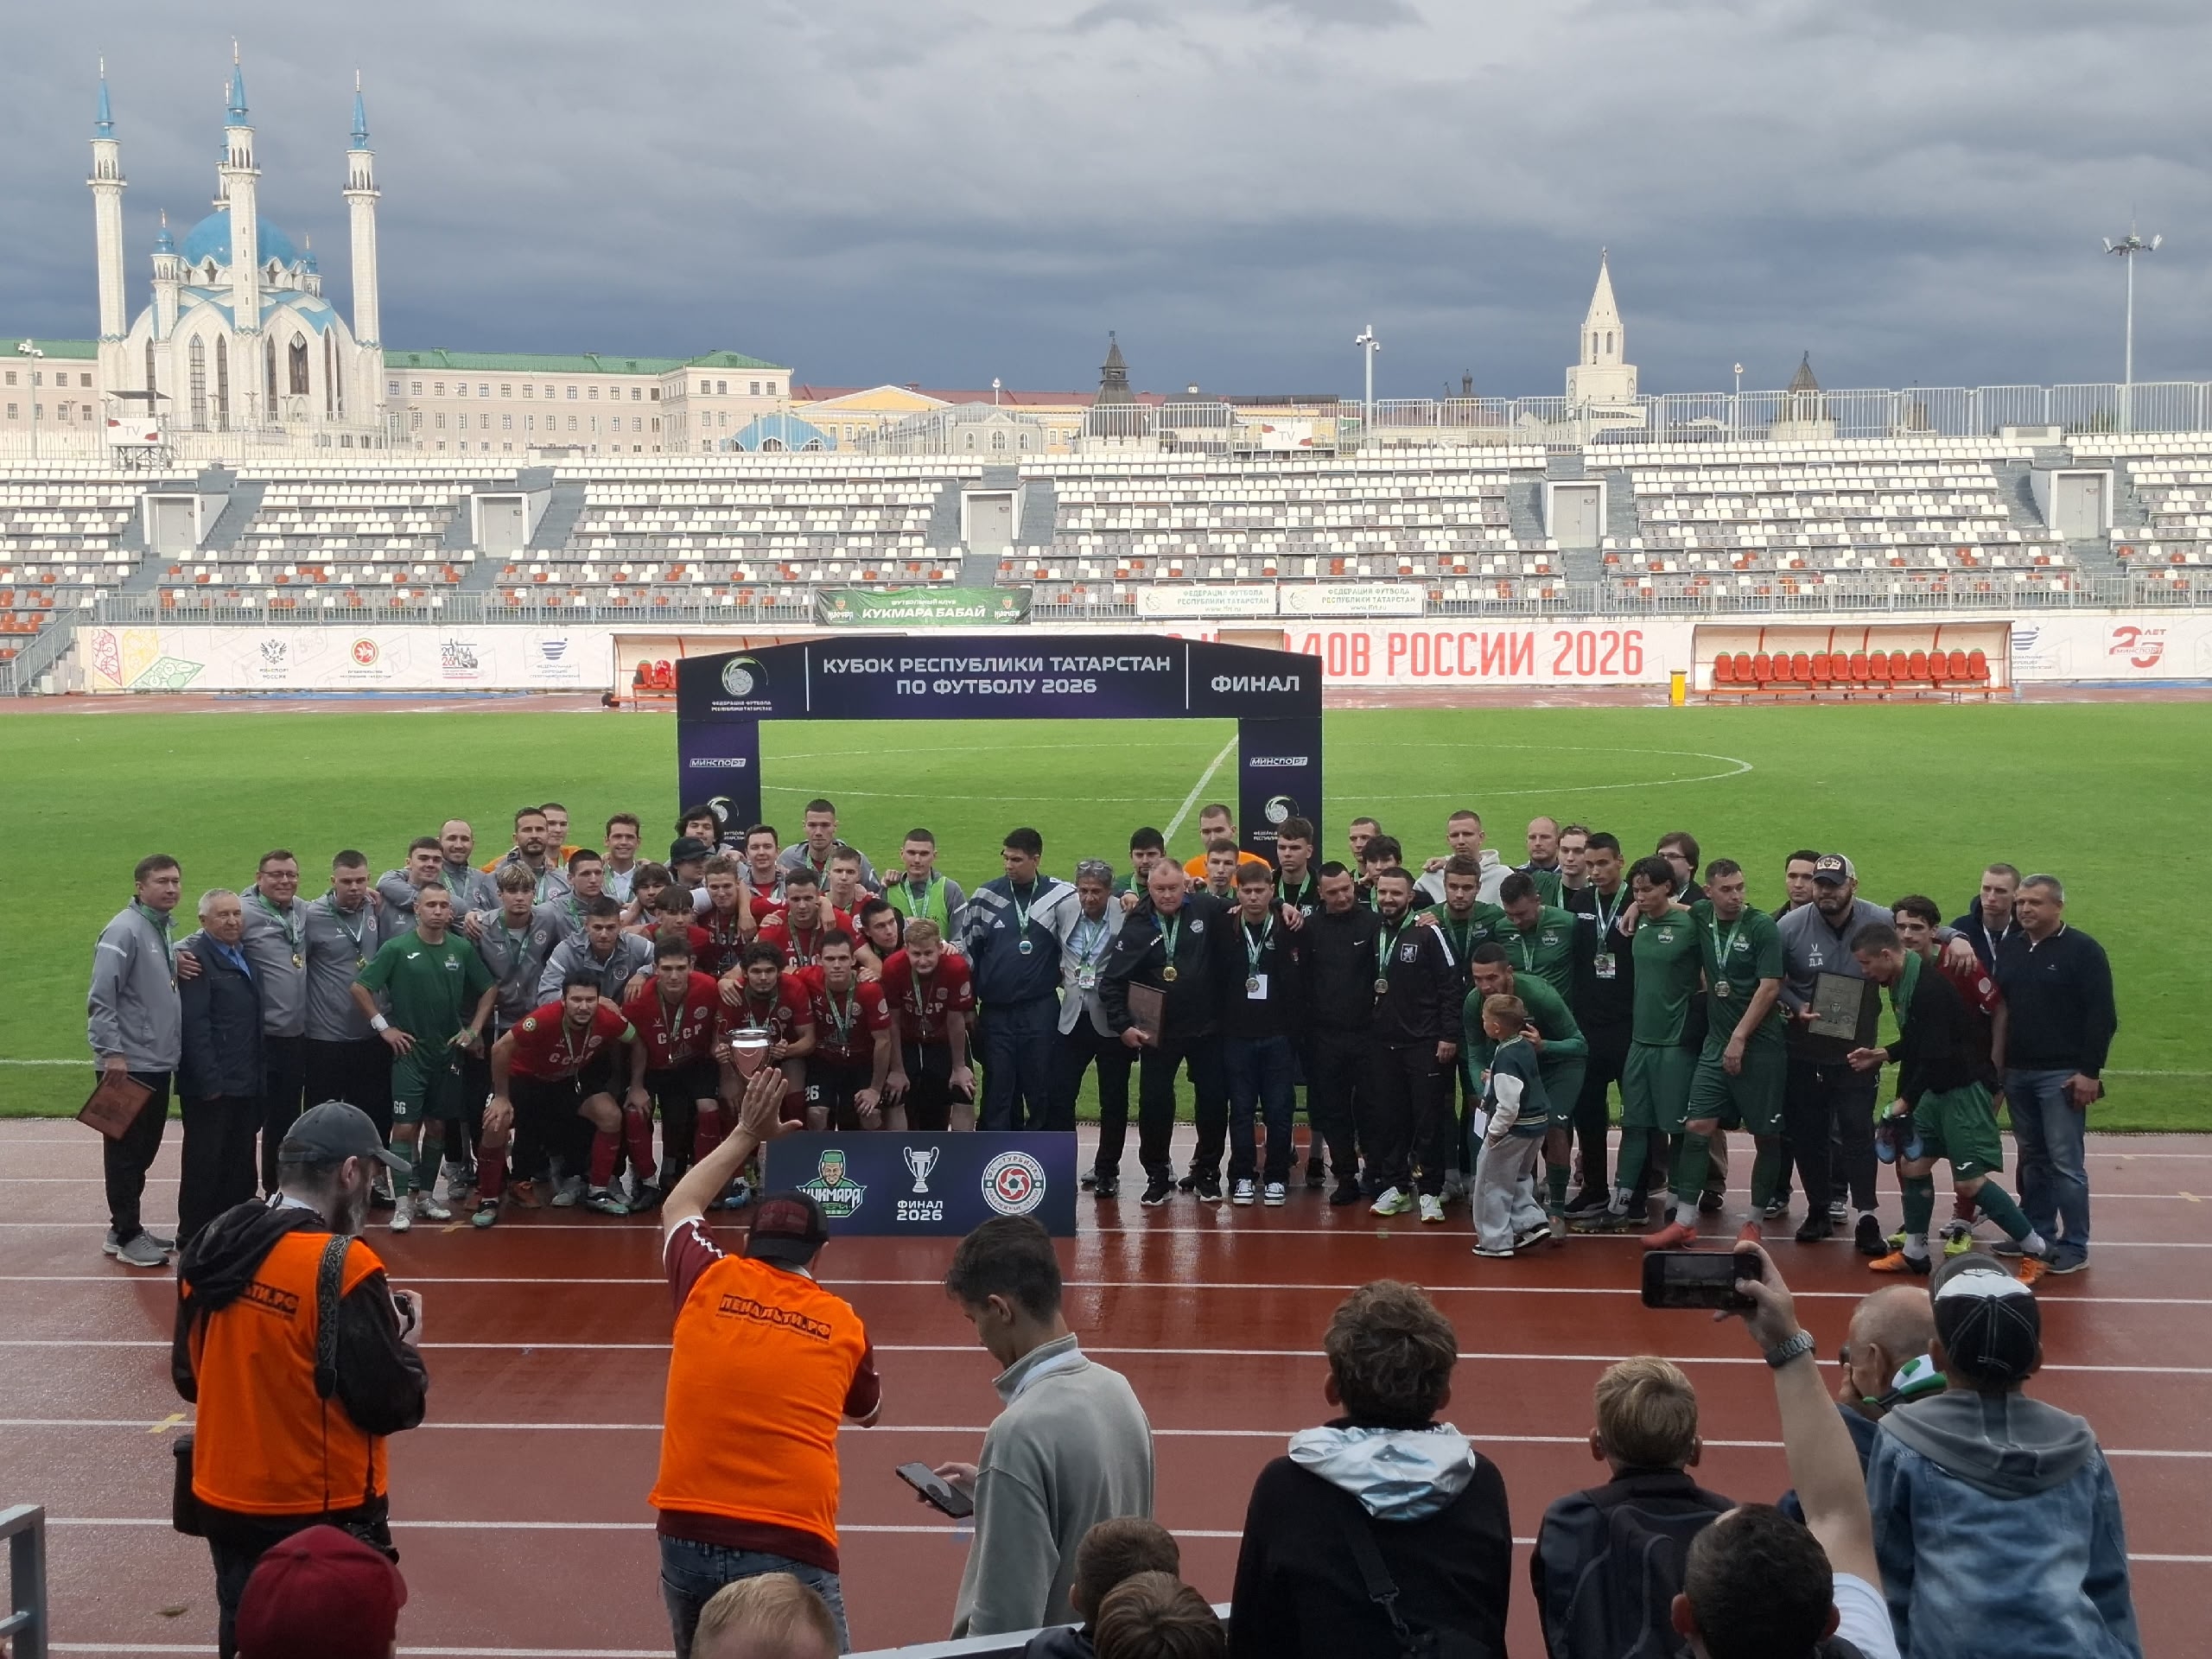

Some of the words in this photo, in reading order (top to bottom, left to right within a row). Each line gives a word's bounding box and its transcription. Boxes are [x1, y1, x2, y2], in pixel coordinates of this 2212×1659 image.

[124, 426, 140, 435] TV
[1279, 431, 1295, 442] TV
[862, 608, 934, 619] КУКМАРА
[936, 606, 986, 619] БАБАЙ
[1388, 632, 1535, 677] РОССИИ
[1553, 630, 1643, 676] 2026
[823, 658, 894, 673] КУБОК
[899, 657, 1044, 672] РЕСПУБЛИКИ
[1050, 657, 1170, 671] ТАТАРСТАН
[897, 680, 926, 694] ПО
[933, 678, 1036, 694] ФУТБОЛУ
[1041, 678, 1097, 693] 2026
[1211, 676, 1300, 692] ФИНАЛ
[690, 759, 746, 767] МИНСПОРТ
[1250, 757, 1307, 766] МИНСПОРТ
[394, 1100, 406, 1115] 66
[898, 1200, 943, 1209] ФИНАЛ
[897, 1210, 943, 1220] 2026
[720, 1296, 831, 1336] ПЕНАЛЬТИ.РФ
